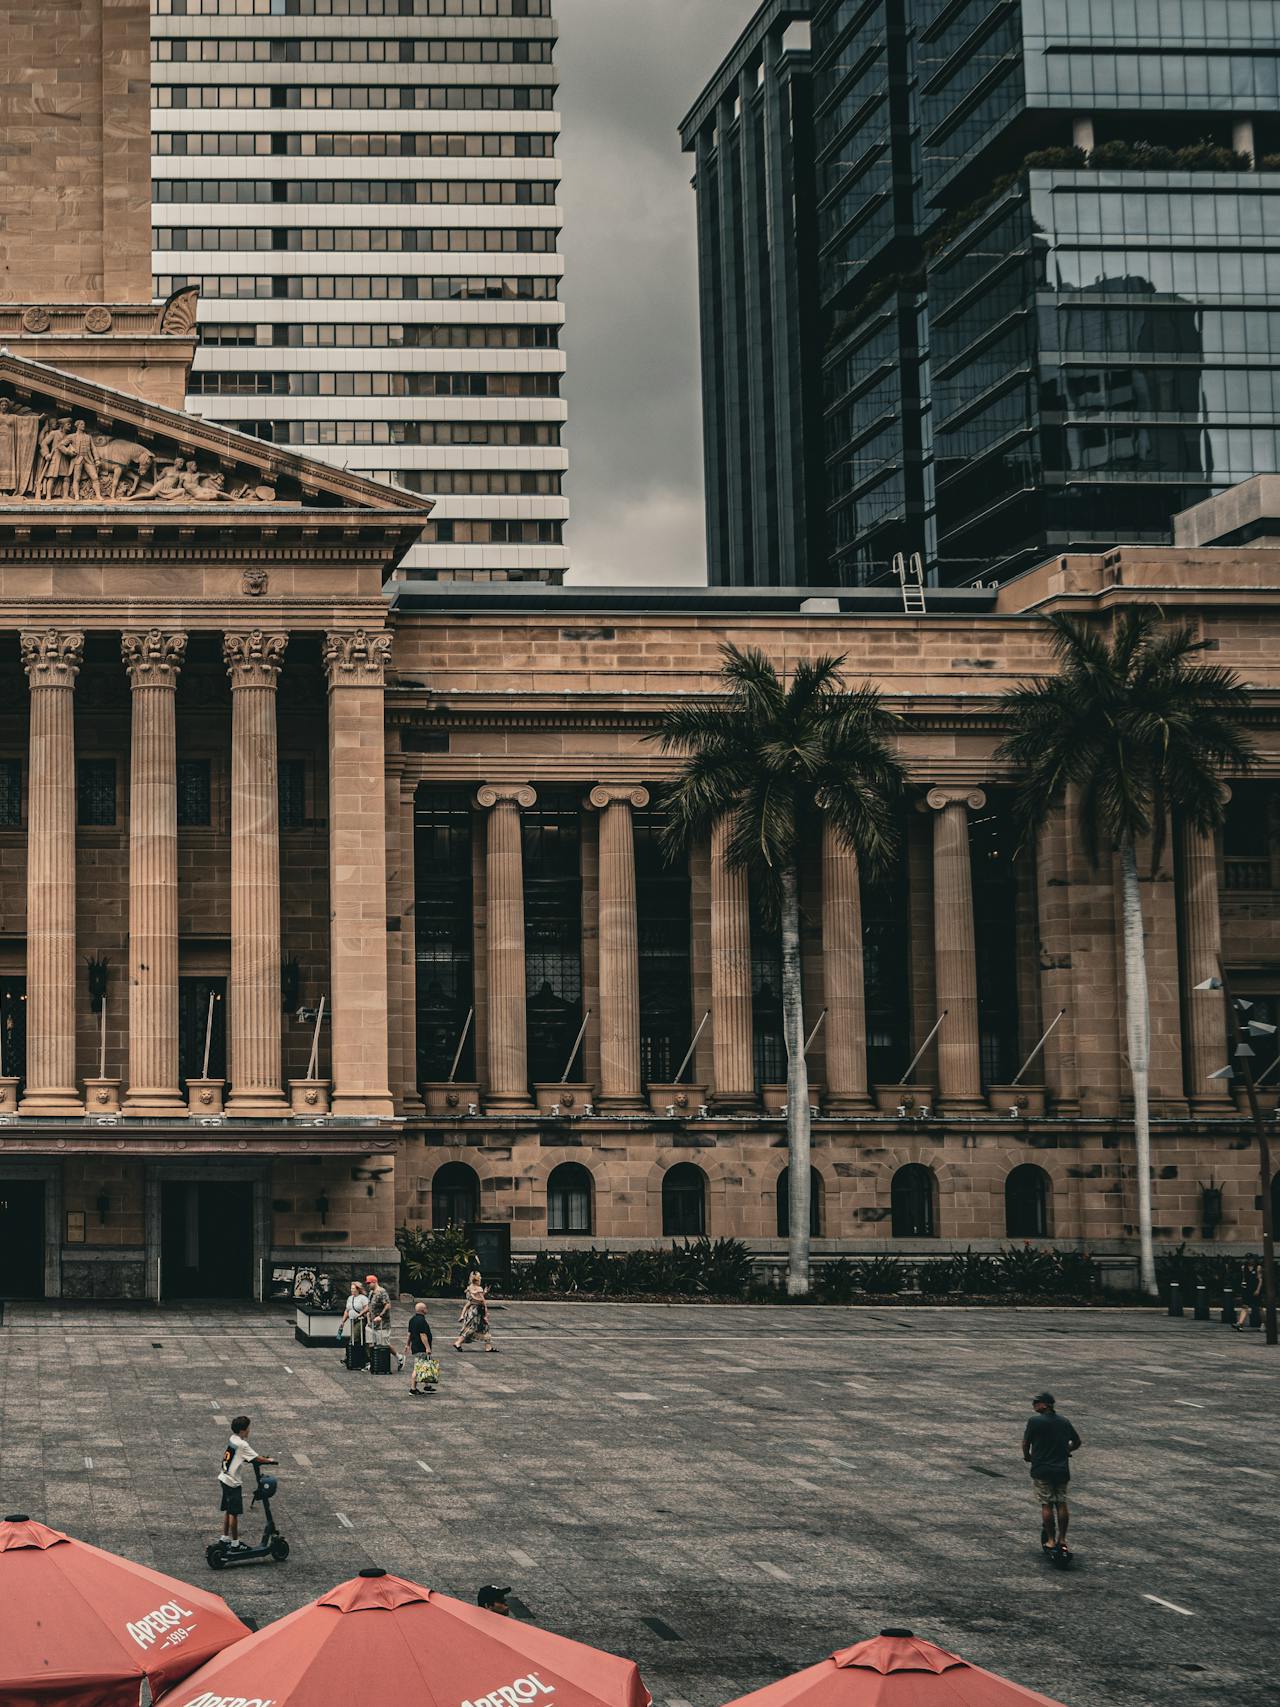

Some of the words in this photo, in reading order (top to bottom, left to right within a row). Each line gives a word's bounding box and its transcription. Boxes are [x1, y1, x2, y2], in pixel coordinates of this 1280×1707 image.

[126, 1600, 193, 1650] APEROL
[166, 1627, 189, 1645] 1919
[461, 1672, 555, 1707] EROL
